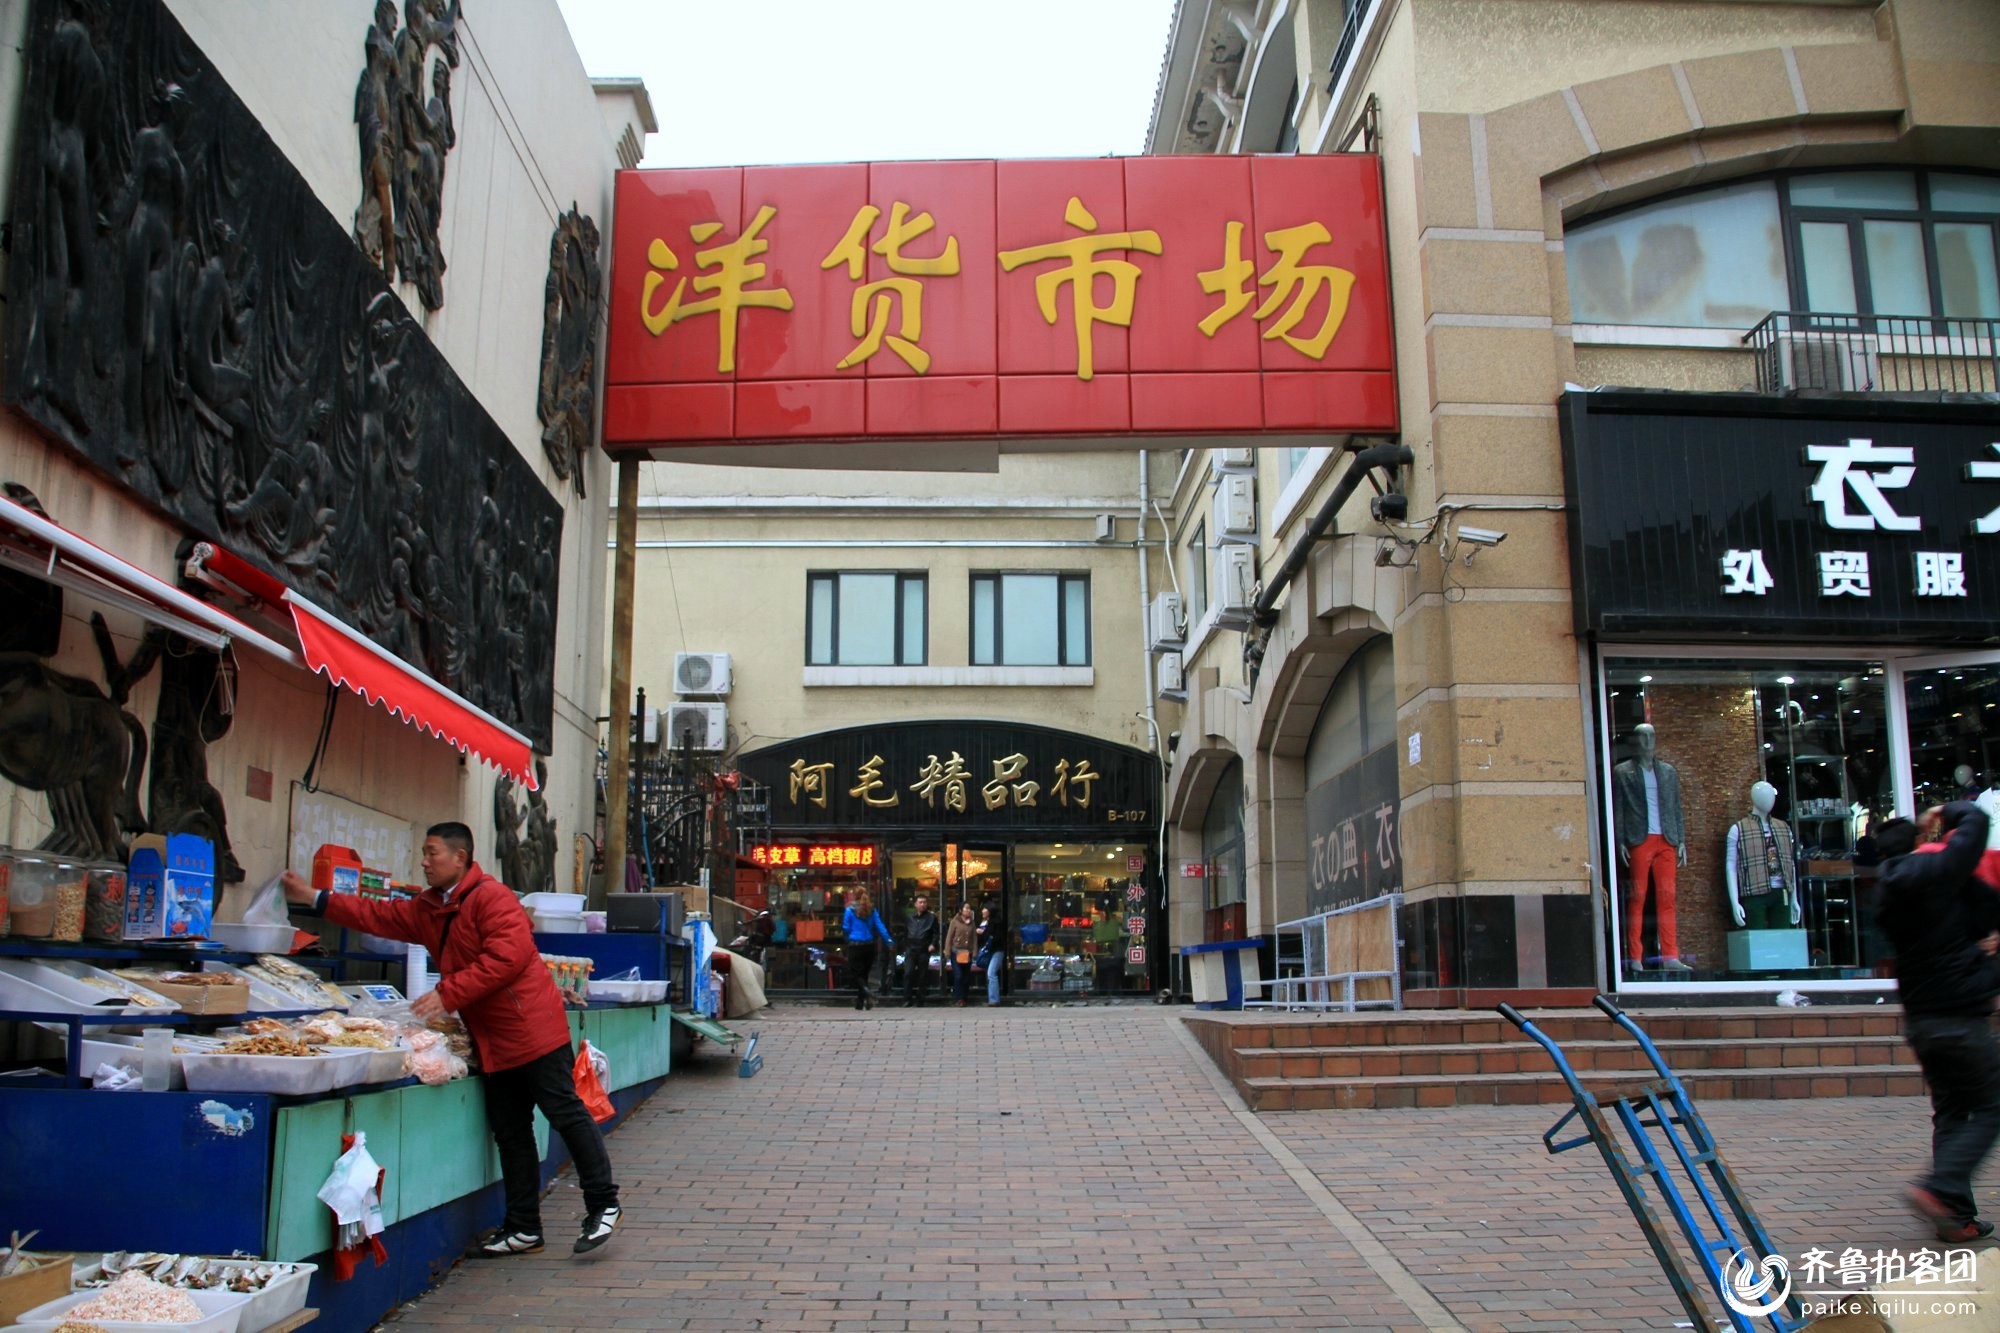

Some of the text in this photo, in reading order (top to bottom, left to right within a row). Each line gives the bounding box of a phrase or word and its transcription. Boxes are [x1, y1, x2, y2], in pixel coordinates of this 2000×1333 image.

[640, 196, 1356, 380] 洋货市场
[1721, 549, 1968, 598] 外贸服
[788, 751, 1100, 814] 阿毛精品行
[1107, 810, 1147, 822] B-107
[1311, 801, 1403, 890] 衣の典 衣
[1126, 855, 1146, 964] 国外带回
